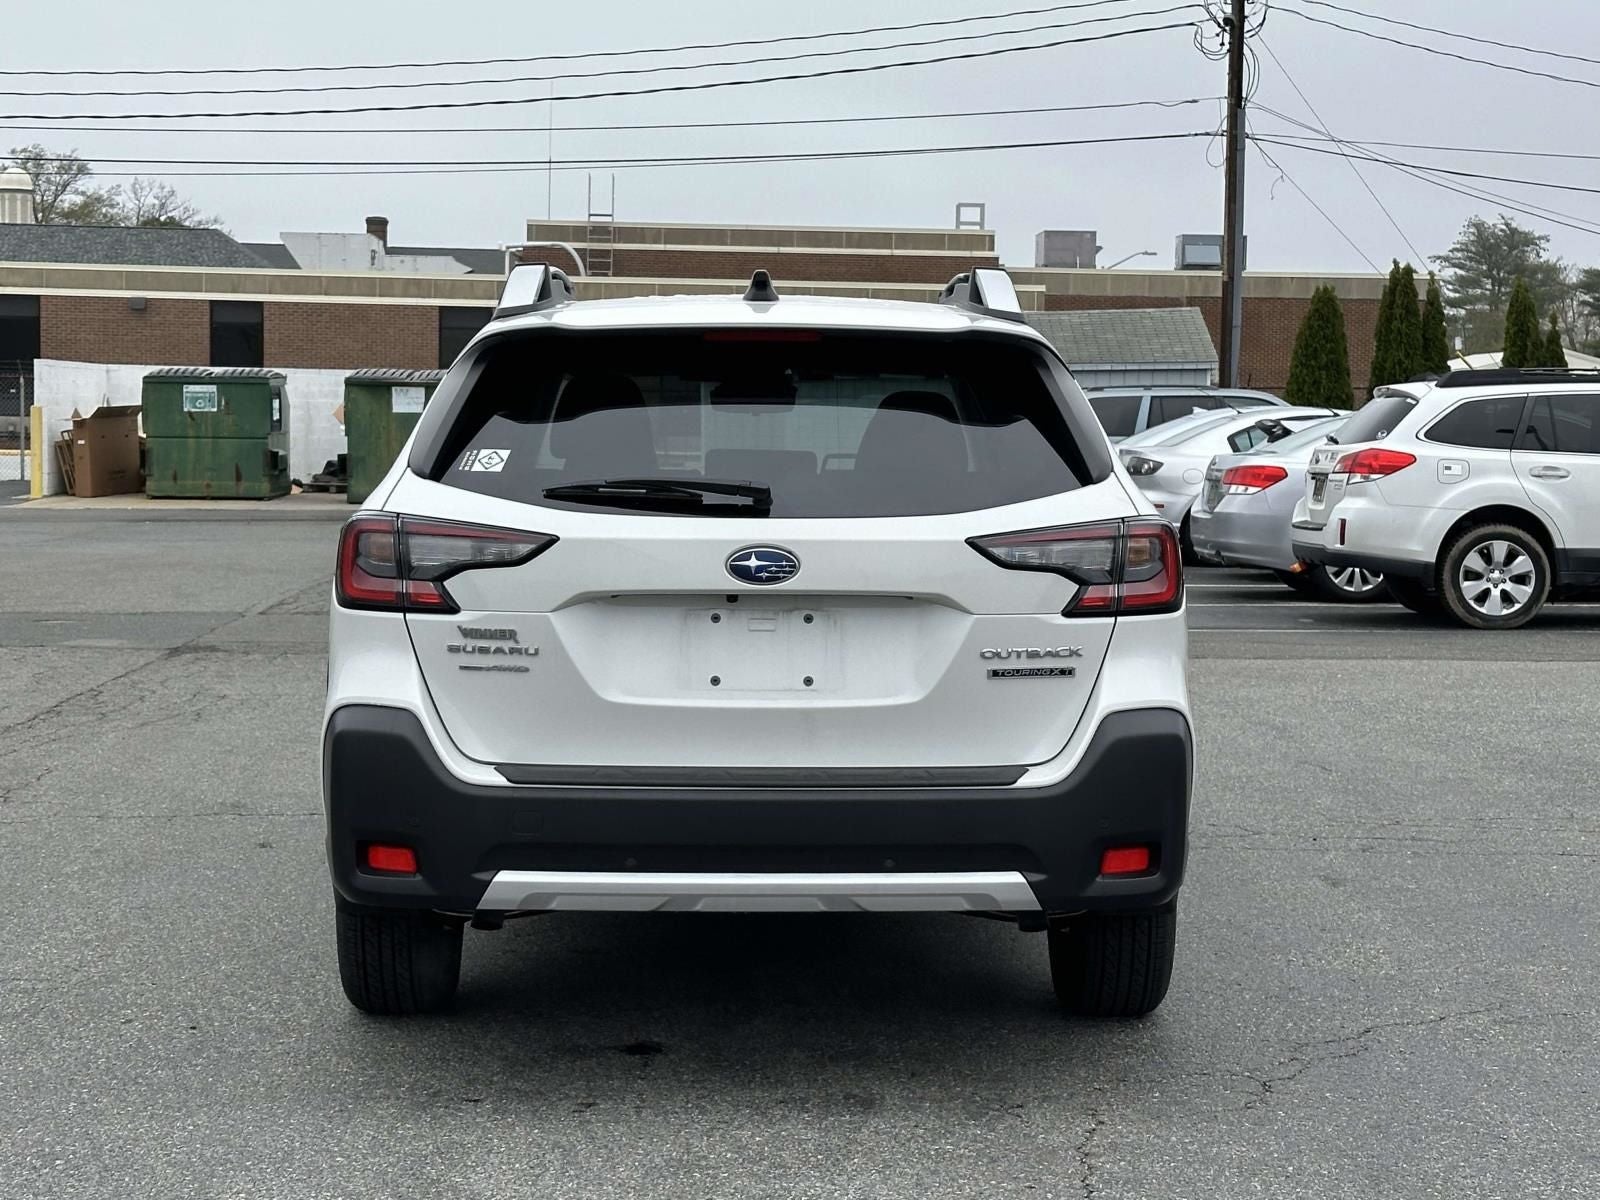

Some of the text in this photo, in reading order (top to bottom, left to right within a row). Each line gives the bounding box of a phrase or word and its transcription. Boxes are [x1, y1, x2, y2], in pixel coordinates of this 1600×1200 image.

[457, 625, 520, 644] WINNER
[447, 643, 539, 656] SUBARU
[980, 646, 1083, 659] OUTBACK
